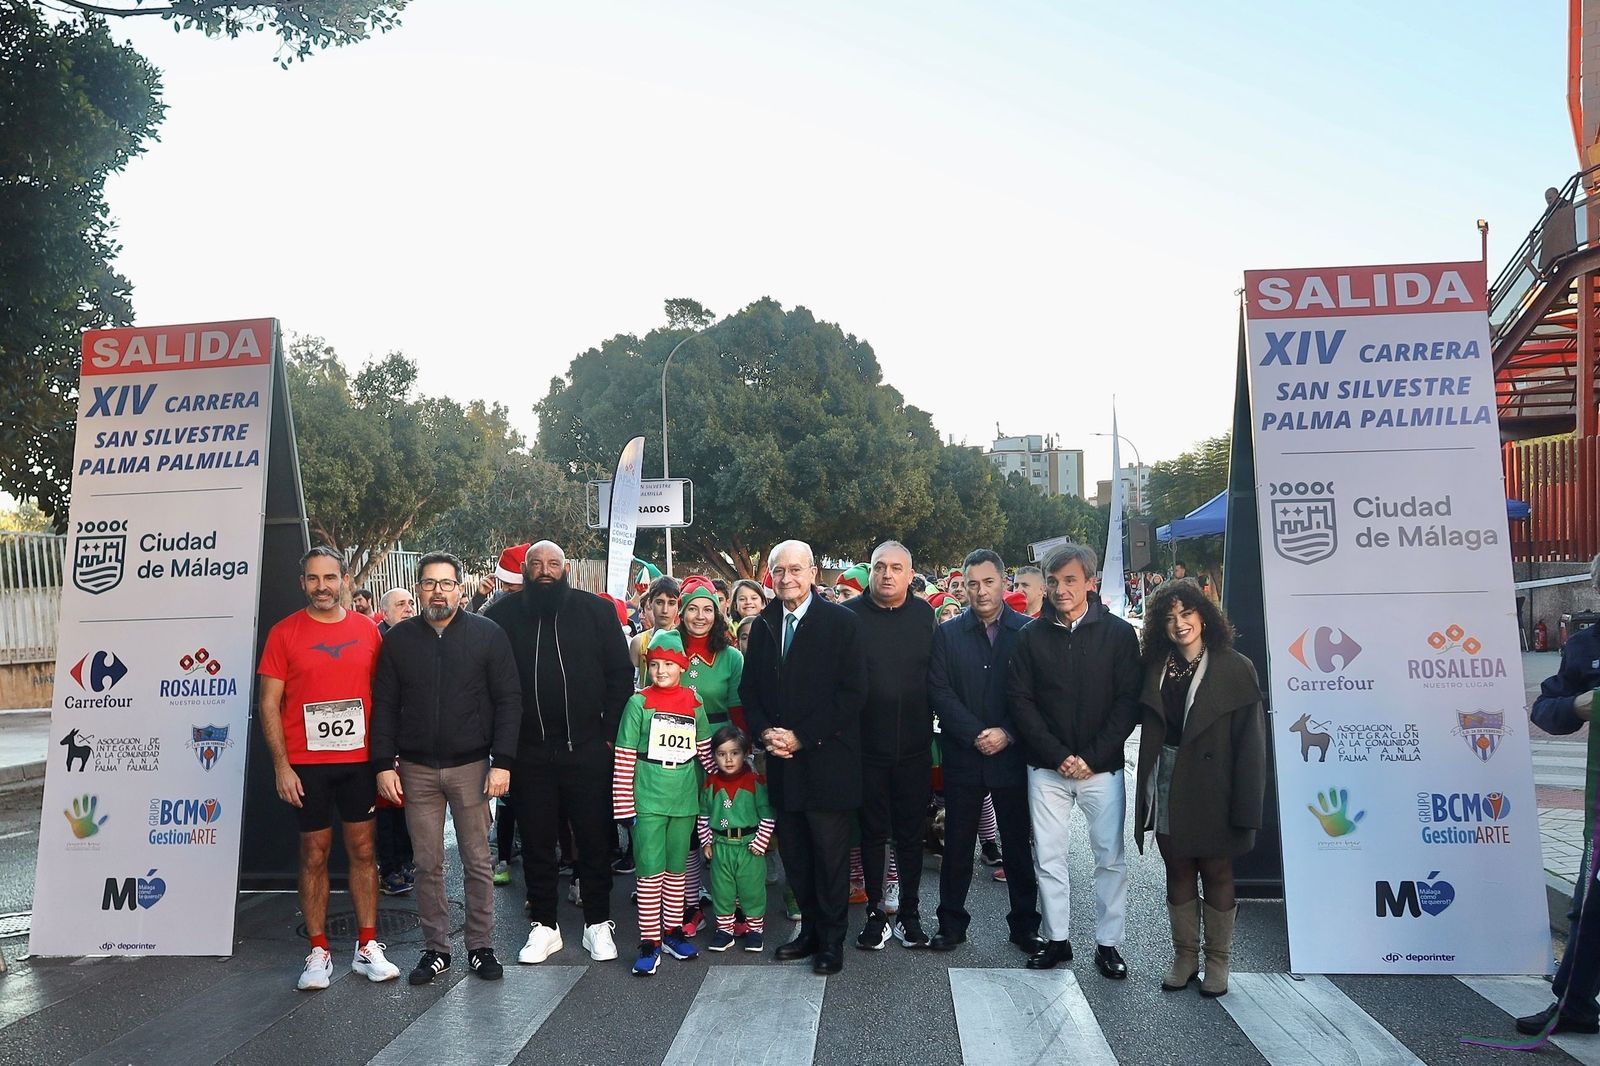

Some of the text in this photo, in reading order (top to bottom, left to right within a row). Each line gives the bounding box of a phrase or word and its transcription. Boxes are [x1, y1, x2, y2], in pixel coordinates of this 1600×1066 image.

[1257, 270, 1474, 312] SALIDA
[92, 327, 262, 368] SALIDA
[1259, 329, 1480, 366] XIV CARRERA
[1276, 376, 1471, 401] SAN SILVESTRE
[85, 383, 260, 418] XIV CARRERA
[1262, 405, 1492, 431] PALMA PALMILLA
[94, 423, 249, 449] SAN SILVESTRE
[79, 449, 260, 476] PALMA PALMILLA
[638, 505, 670, 513] RADOS
[1353, 495, 1452, 519] Ciudad
[139, 530, 217, 553] Ciudad
[1355, 525, 1498, 551] de Málaga
[137, 557, 249, 580] de Málaga
[1408, 657, 1507, 680] ROSALEDA
[160, 678, 238, 697] ROSALEDA
[1287, 676, 1375, 692] Carrefour
[1465, 681, 1494, 689] LUGAR
[64, 695, 133, 710] Carrefour
[203, 698, 226, 706] LUGAR
[317, 718, 356, 739] 962
[1404, 723, 1418, 732] DE
[149, 737, 160, 745] DE
[658, 733, 692, 750] 1021
[1338, 739, 1420, 747] A LA COMUNIDAD
[95, 751, 102, 759] A
[104, 751, 114, 759] LA
[1339, 754, 1422, 762] PALMA PALMILLA
[149, 798, 160, 827] GRUPO
[160, 799, 199, 826] BCM
[1417, 791, 1431, 823] GRUPO
[1431, 793, 1483, 823] BCM
[149, 828, 217, 845] GestionARTE
[1422, 826, 1511, 844] GestionARTE
[117, 942, 156, 951] deporinter
[1405, 953, 1455, 963] deporinter
